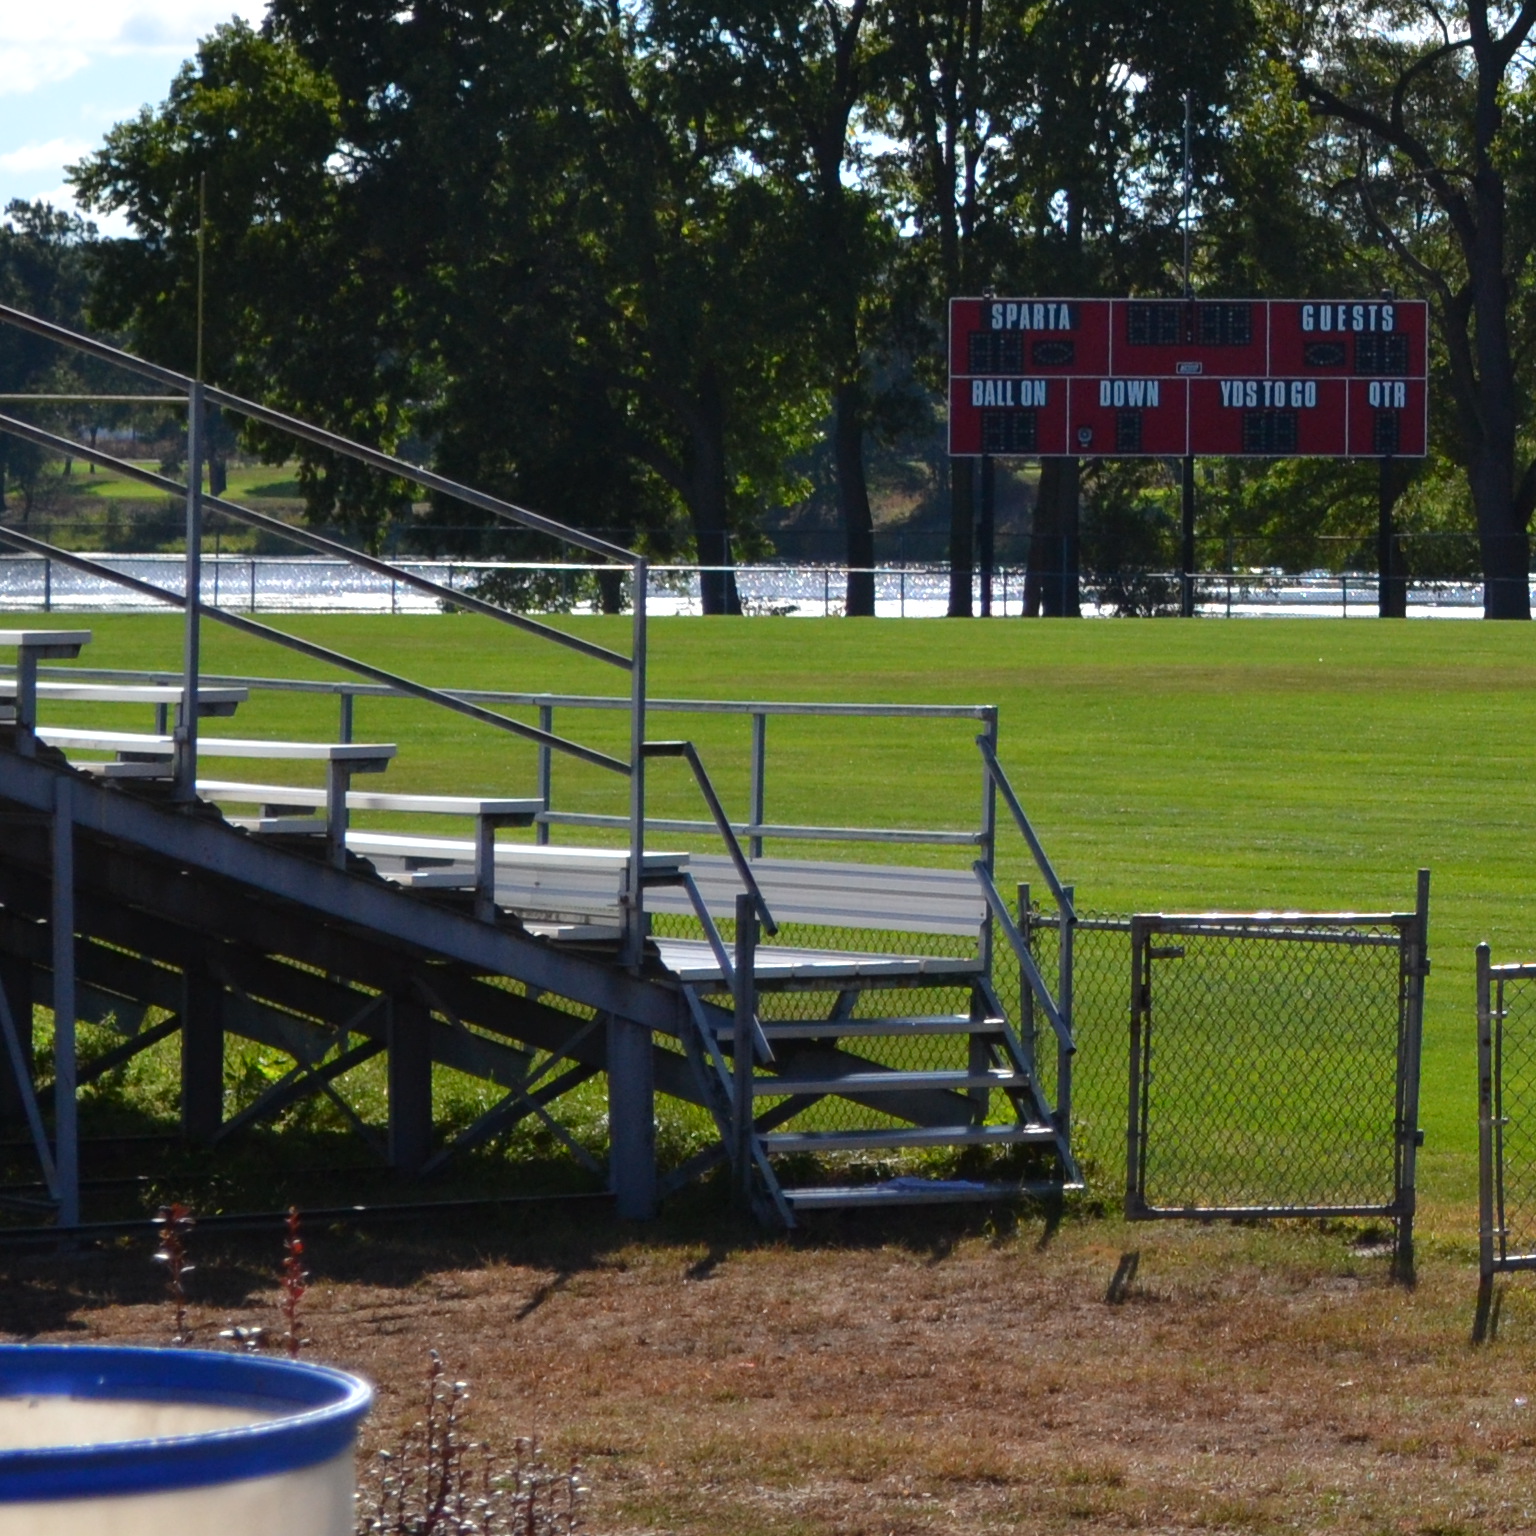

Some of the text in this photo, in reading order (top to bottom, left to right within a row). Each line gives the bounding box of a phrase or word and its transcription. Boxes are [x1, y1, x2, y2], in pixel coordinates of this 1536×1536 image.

[991, 304, 1070, 330] SPARTA
[1302, 305, 1394, 331] GUESTS
[972, 381, 1046, 406] BALL ON
[1100, 381, 1159, 407] DOWN
[1221, 381, 1316, 408] YDS TO GO
[1369, 382, 1405, 408] QTR
